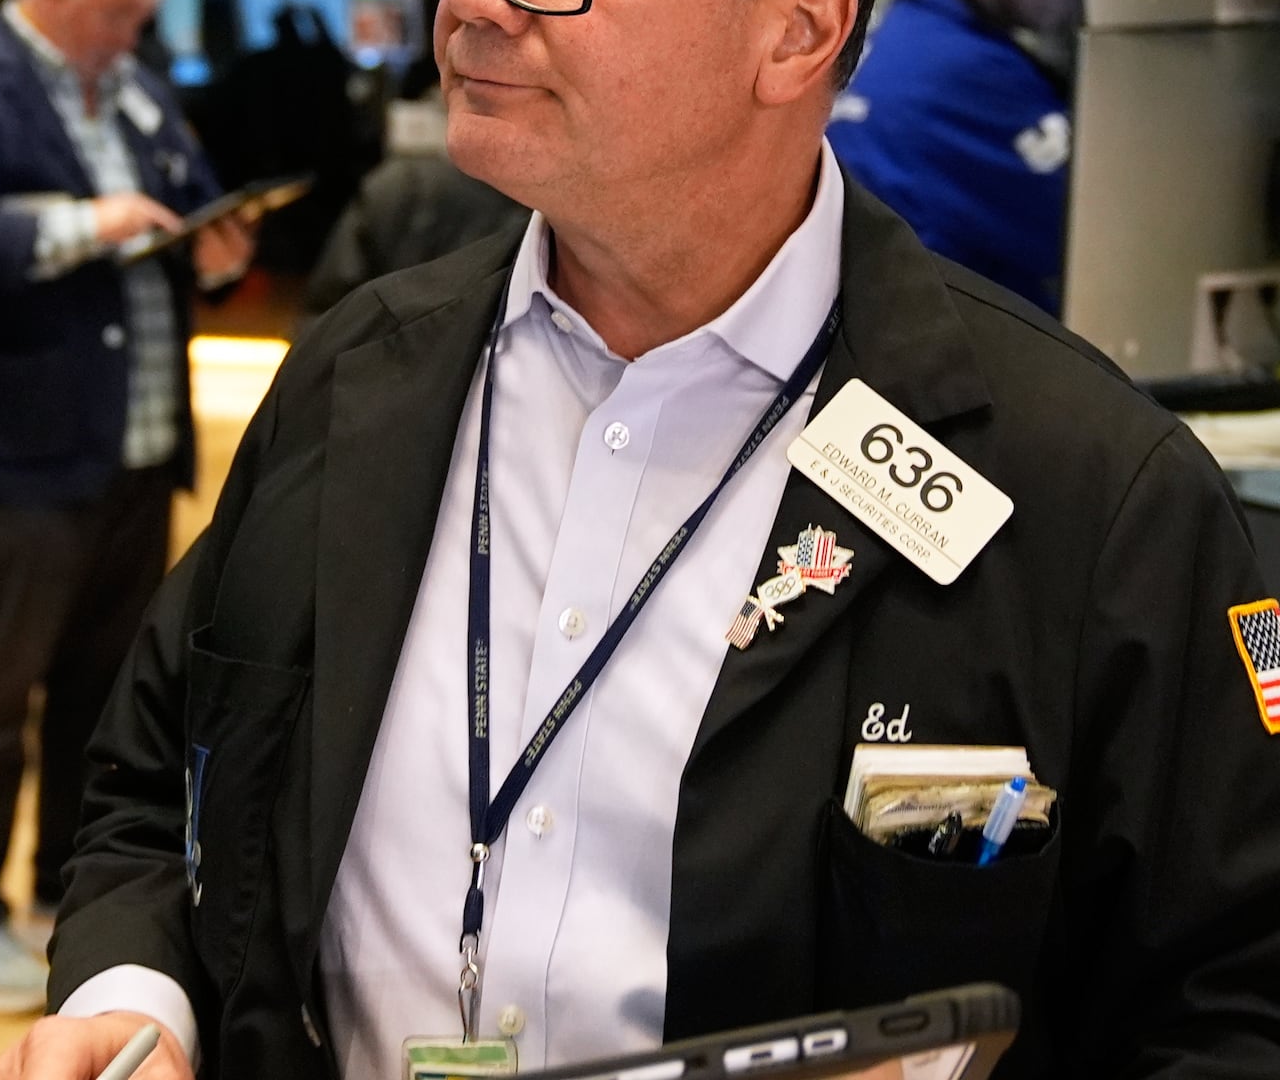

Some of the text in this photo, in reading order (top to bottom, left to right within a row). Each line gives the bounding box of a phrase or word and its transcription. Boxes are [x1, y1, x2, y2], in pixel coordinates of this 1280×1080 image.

[761, 395, 790, 434] PENN
[810, 459, 818, 470] E
[820, 467, 829, 479] &
[830, 476, 839, 486] J
[839, 483, 899, 535] SECURITIES
[822, 442, 877, 489] EDWARD
[895, 502, 950, 549] CURRAN
[860, 423, 963, 512] 636
[478, 515, 489, 555] PENN
[631, 527, 688, 607] PENN STATE
[475, 645, 487, 738] PENN STATE
[526, 679, 583, 761] PENN STATE
[861, 702, 912, 743] Ed
